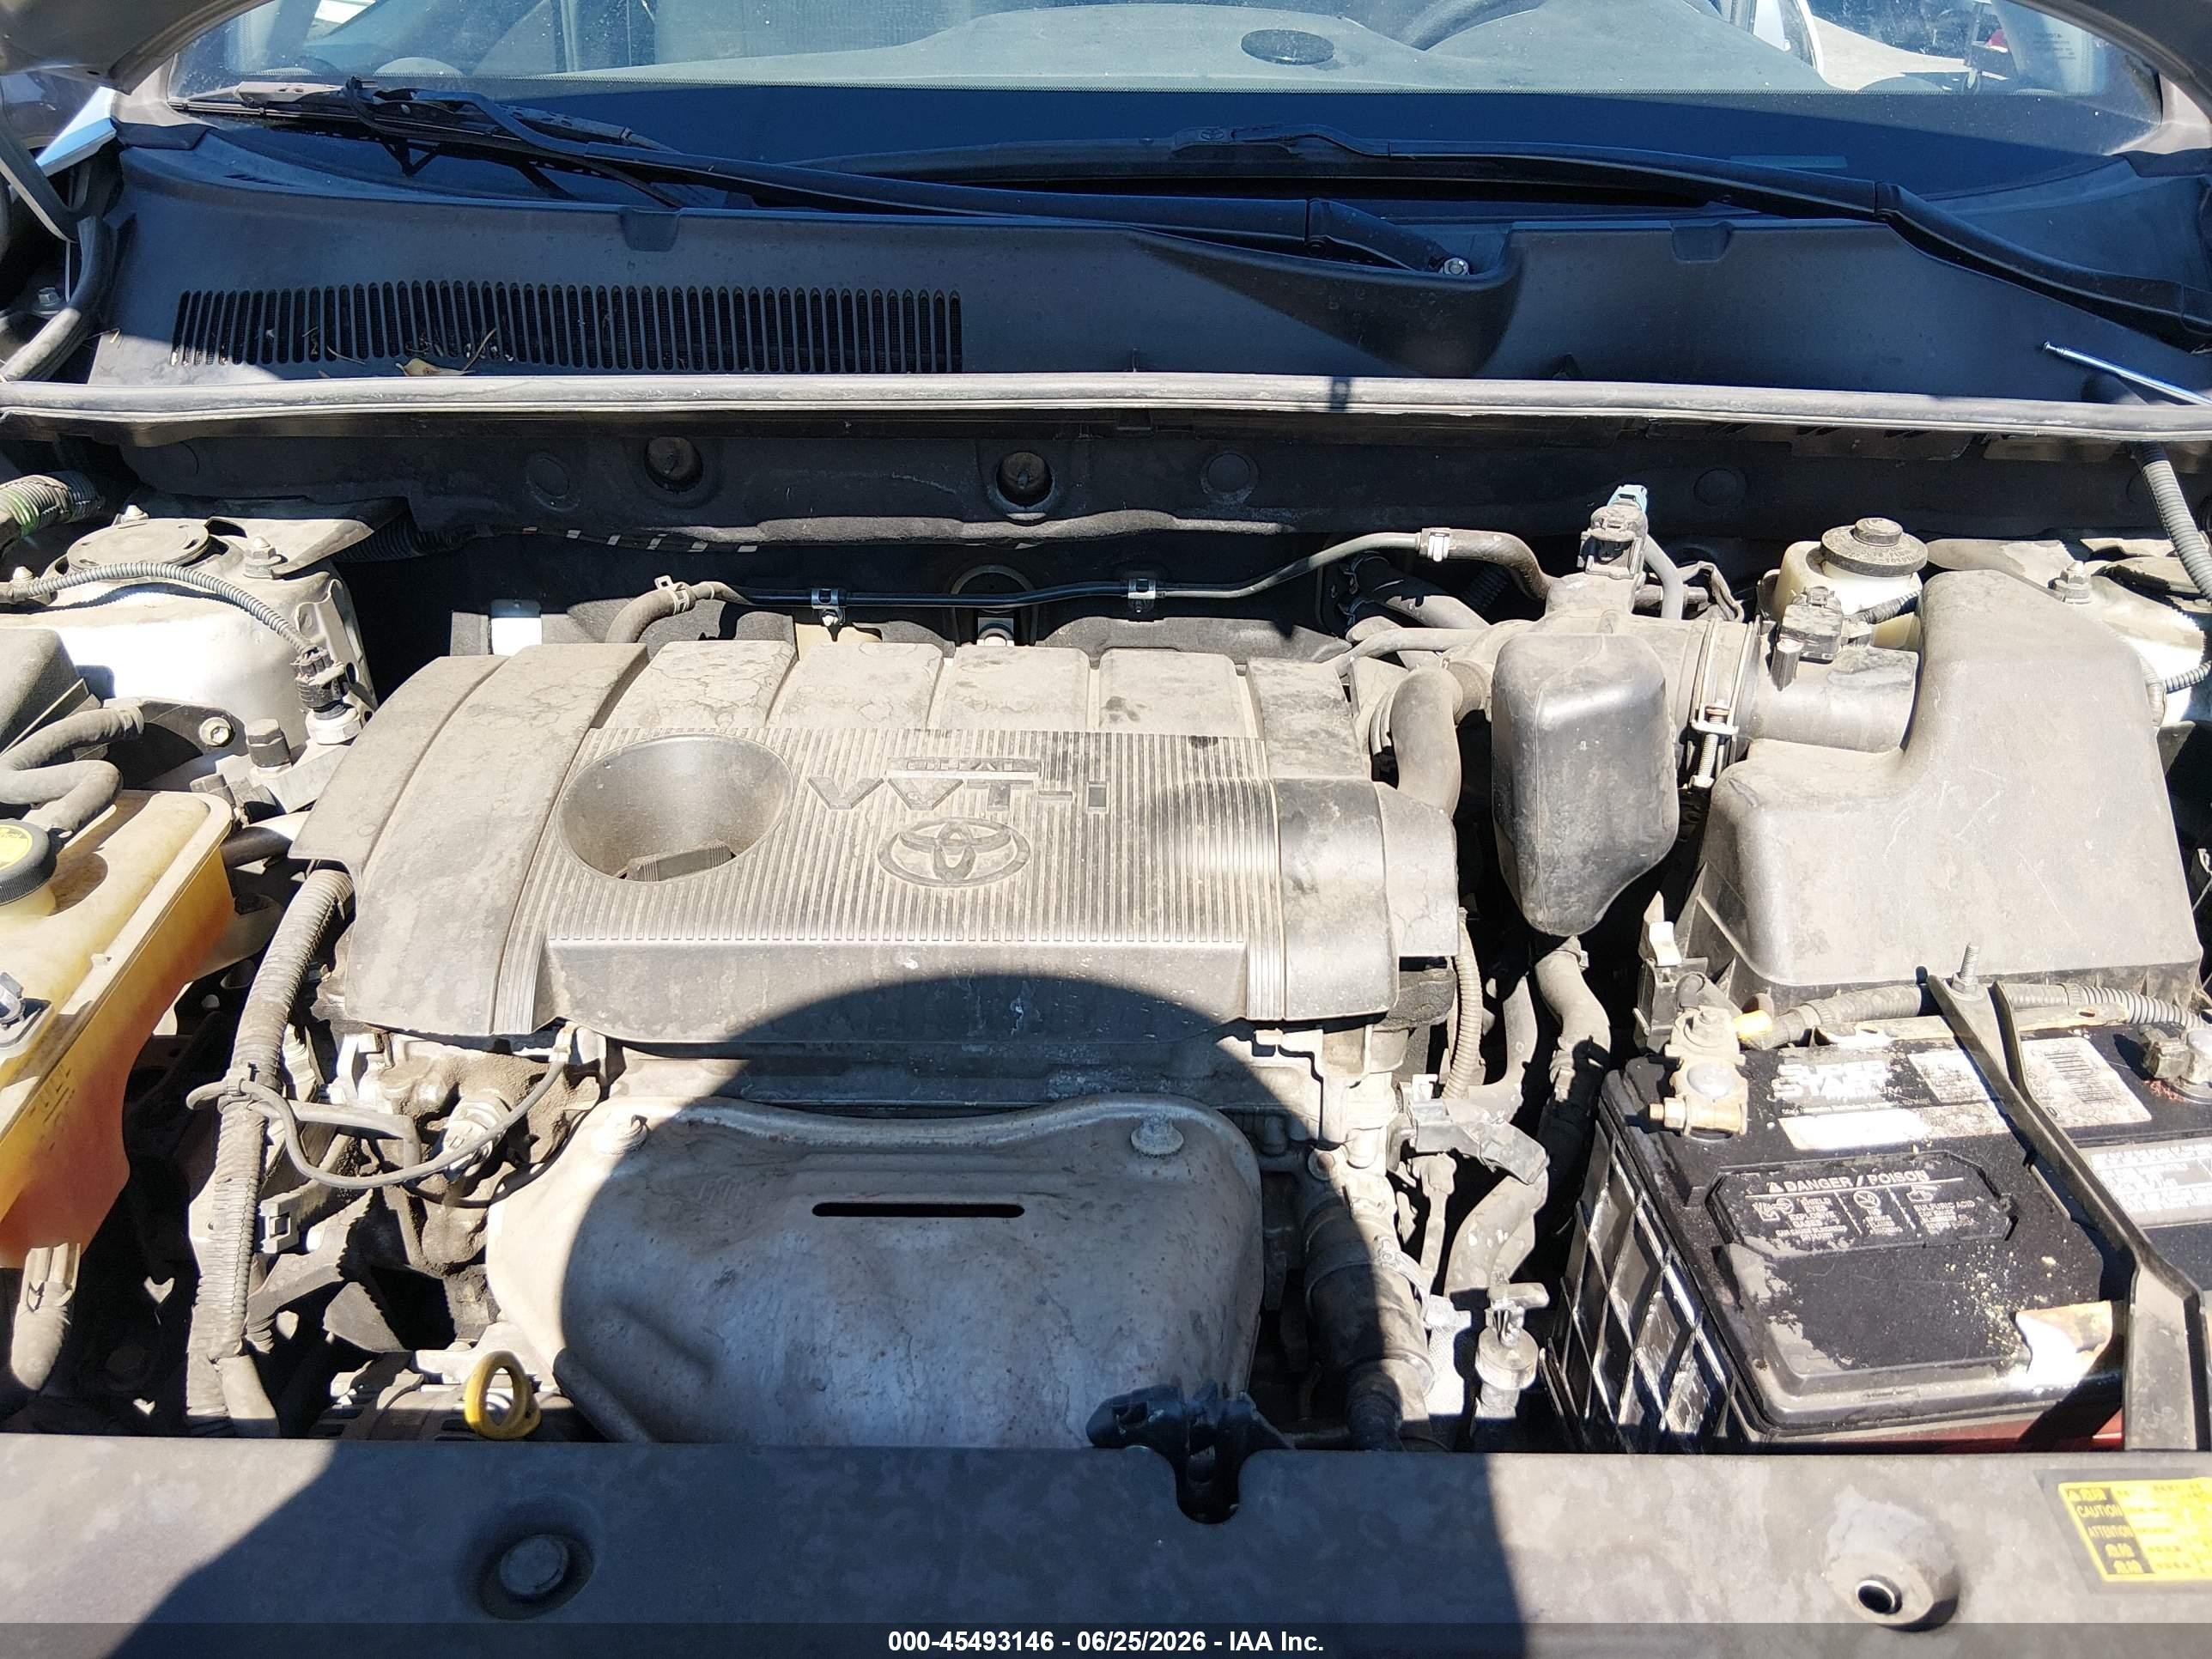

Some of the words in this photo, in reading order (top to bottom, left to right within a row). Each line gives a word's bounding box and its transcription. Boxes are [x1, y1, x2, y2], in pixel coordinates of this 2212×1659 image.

[1783, 1176, 1854, 1193] DANGER
[1866, 1170, 1930, 1186] POISON
[1955, 1200, 1976, 1209] ACID
[2075, 1504, 2124, 1518] CAUTION
[2087, 1524, 2136, 1539] ATTENTION
